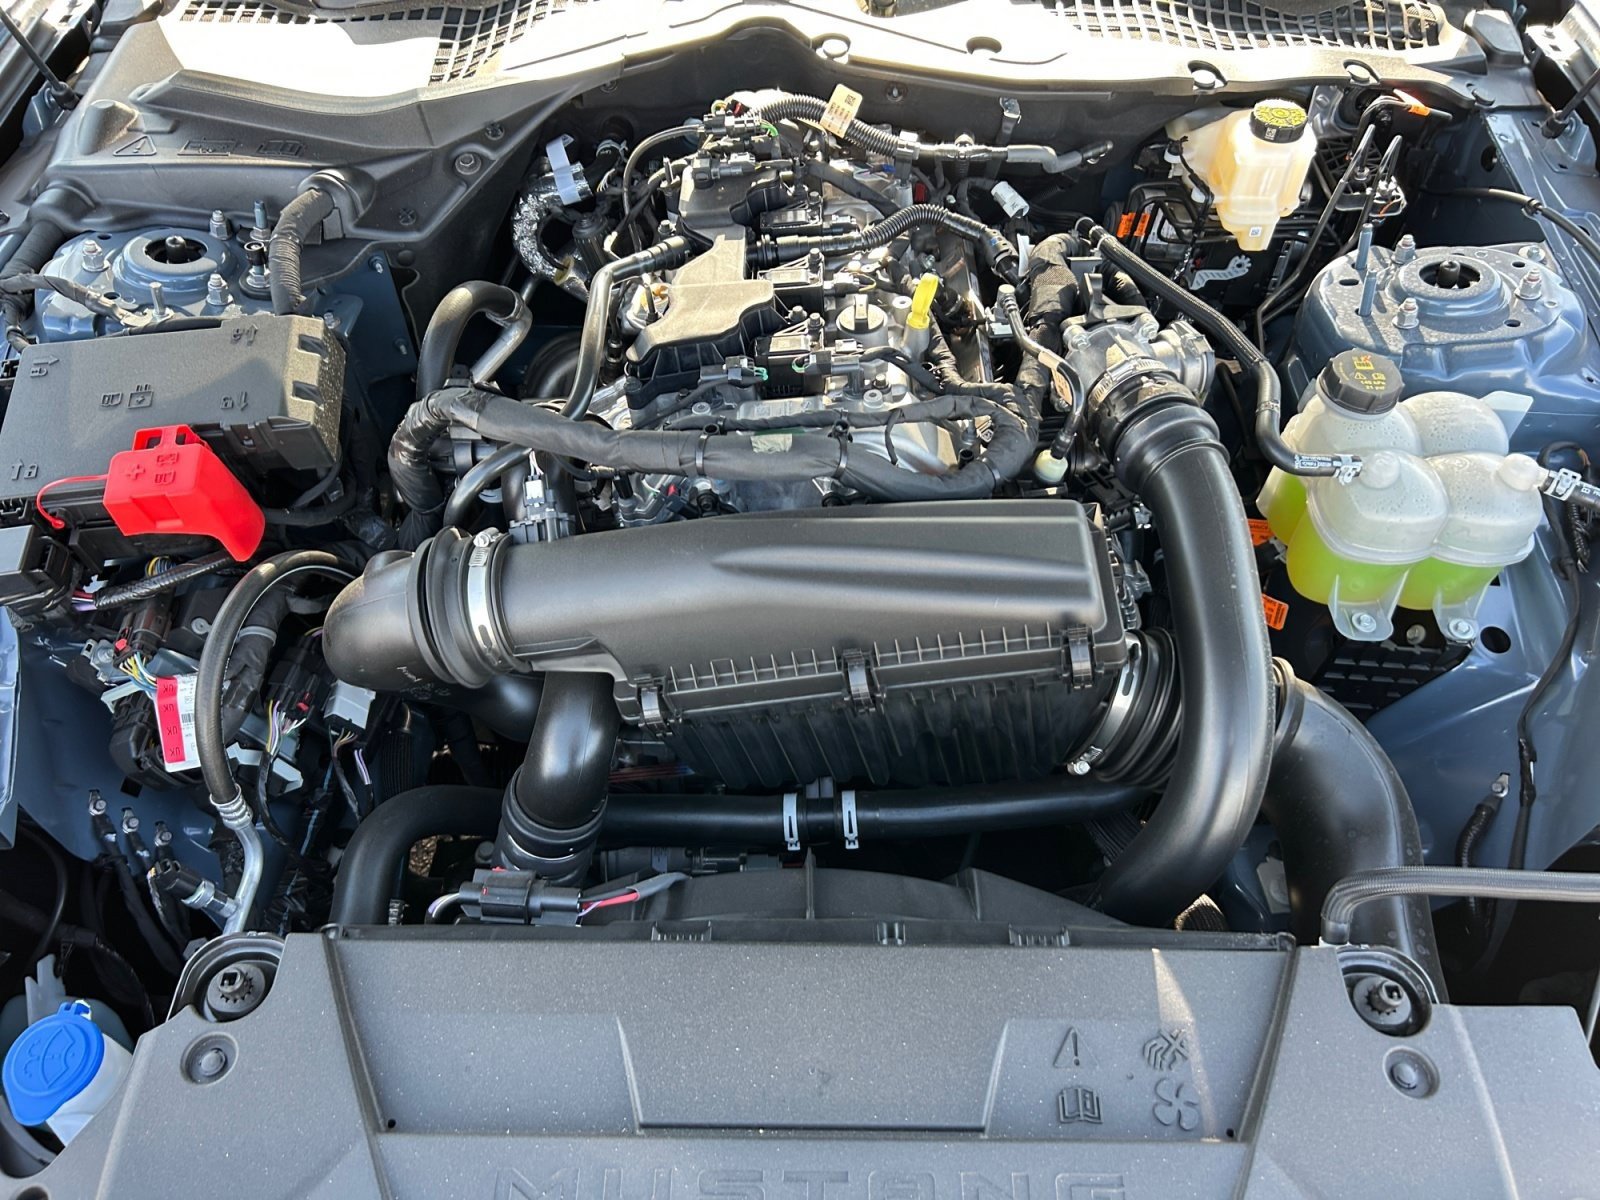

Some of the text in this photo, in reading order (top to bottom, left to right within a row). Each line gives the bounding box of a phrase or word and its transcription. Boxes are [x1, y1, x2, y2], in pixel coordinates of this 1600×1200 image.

[163, 684, 174, 693] UK
[164, 703, 174, 713] UK
[167, 726, 177, 735] UK
[170, 747, 180, 757] UK
[494, 1167, 1125, 1200] MUSTANG
